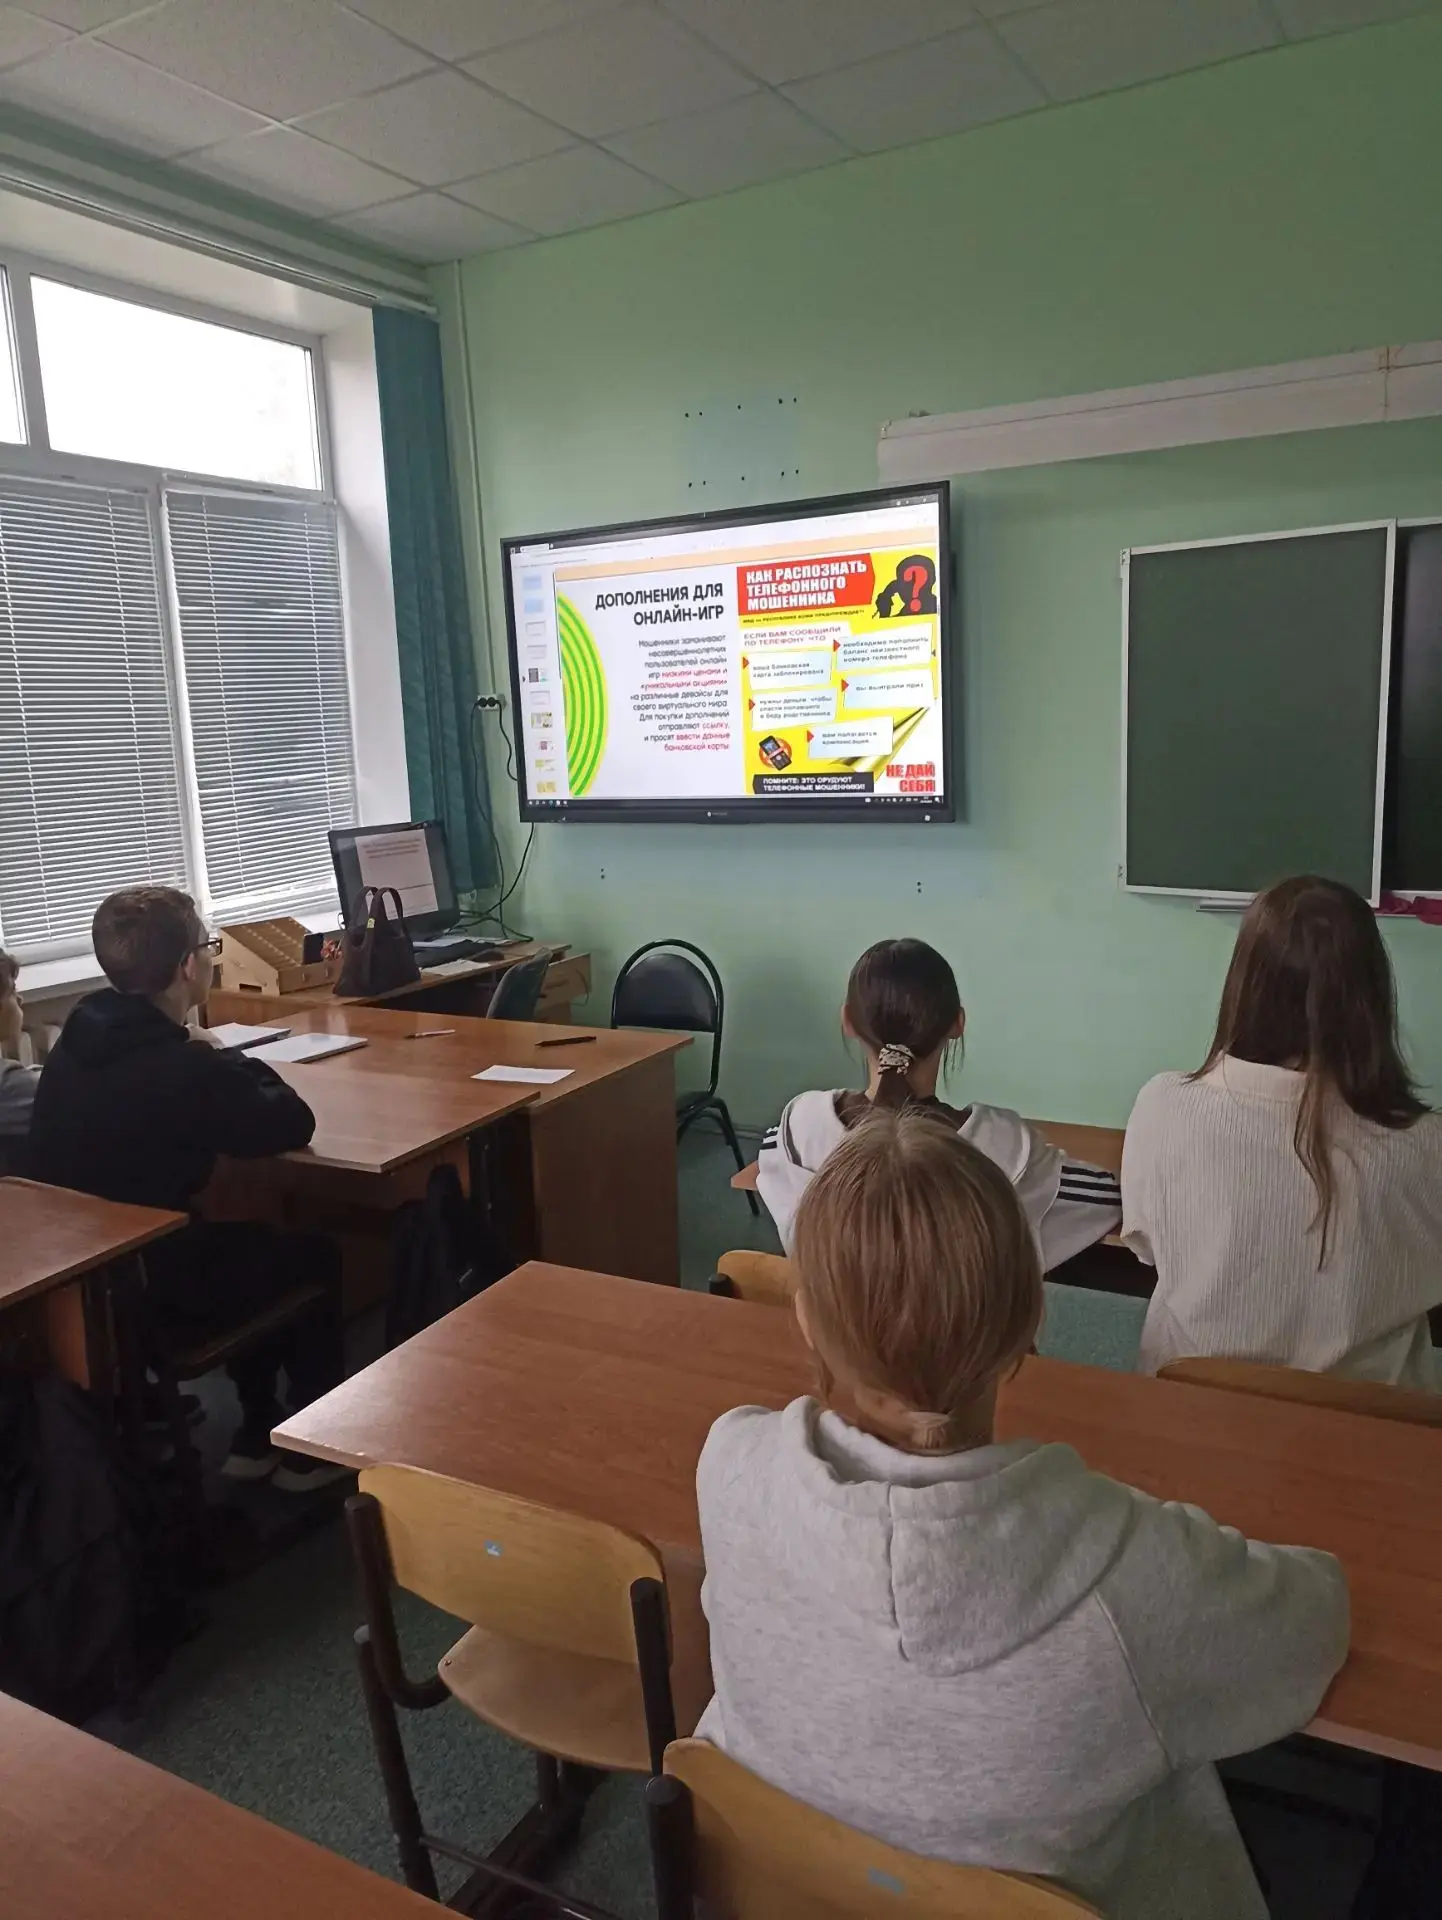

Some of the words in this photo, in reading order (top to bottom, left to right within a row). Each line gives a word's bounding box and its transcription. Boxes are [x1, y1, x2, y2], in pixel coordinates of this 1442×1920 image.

[746, 569, 772, 584] КАК
[775, 560, 867, 580] РАСПОЗНАТЬ
[746, 576, 846, 598] ТЕЛЕФОННОГО
[595, 586, 689, 611] ДОПОЛНЕНИЯ
[693, 583, 724, 602] ДЛЯ
[747, 591, 836, 611] МОШЕННИКА
[633, 604, 724, 626] ОНЛАЙН-ИГР
[743, 631, 767, 639] ЕСЛИ
[768, 630, 788, 638] ВАМ
[789, 626, 841, 636] СООБЩИЛИ
[638, 639, 680, 647] Мошенники
[644, 657, 699, 667] пользователей
[699, 655, 727, 664] онлайн
[662, 669, 692, 678] низкими
[694, 668, 721, 676] ценами
[640, 692, 680, 701] различные
[681, 689, 713, 698] девайсы
[714, 689, 729, 697] для
[658, 701, 707, 710] виртуального
[639, 713, 653, 721] Для
[654, 712, 684, 721] покупки
[685, 709, 730, 719] дополнений
[658, 722, 700, 730] отправляют
[650, 734, 675, 742] просят
[702, 732, 731, 740] данные
[664, 742, 706, 751] банковской
[707, 742, 730, 750] карты
[886, 764, 904, 779] НЕ
[905, 761, 936, 779] ДАЙ
[899, 779, 936, 793] СЕБЯ
